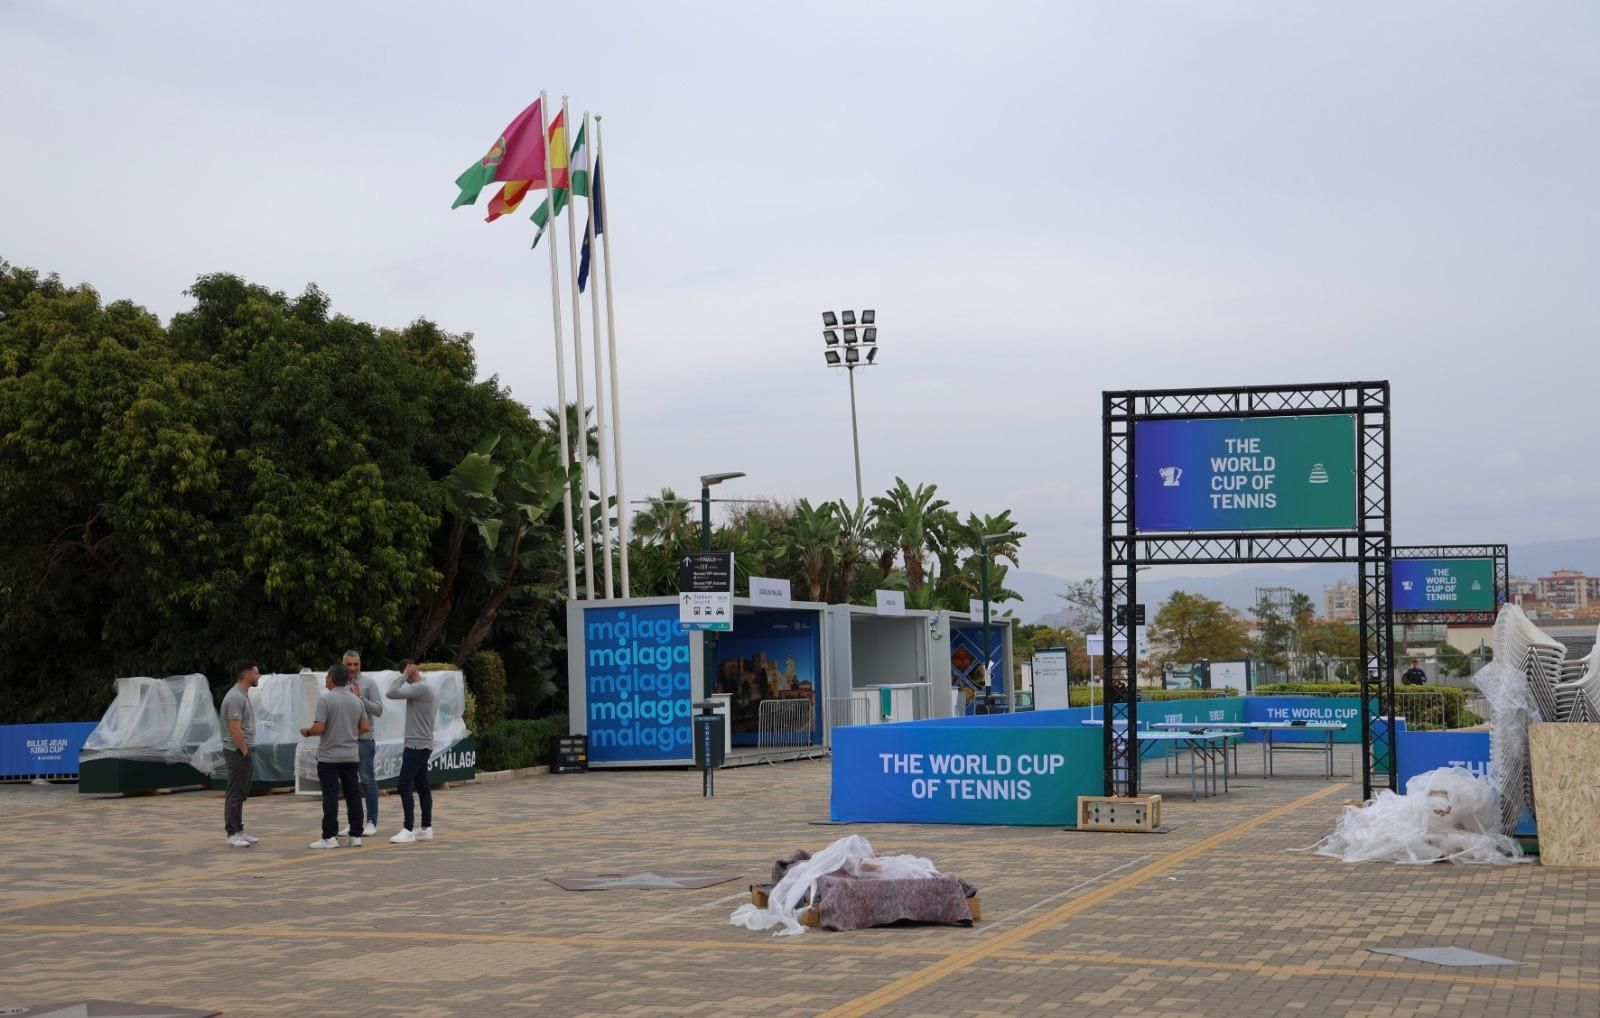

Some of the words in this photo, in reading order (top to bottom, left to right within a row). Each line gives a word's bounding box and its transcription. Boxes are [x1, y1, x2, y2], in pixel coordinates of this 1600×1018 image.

[1225, 438, 1261, 454] THE
[1210, 456, 1276, 473] WORLD
[1211, 475, 1248, 491] CUP
[1251, 474, 1276, 490] OF
[1209, 493, 1277, 509] TENNIS
[1425, 576, 1456, 584] WORLD
[1432, 568, 1450, 576] THE
[1424, 593, 1457, 601] TENNIS
[1267, 708, 1289, 718] THE
[1292, 708, 1332, 718] WORLD
[1334, 708, 1358, 718] CUP
[50, 738, 68, 746] JEAN
[878, 754, 924, 774] THE
[928, 754, 1012, 775] WORLD
[1017, 754, 1065, 776] CUP
[911, 778, 941, 799] OF
[946, 779, 1032, 800] TENNIS
